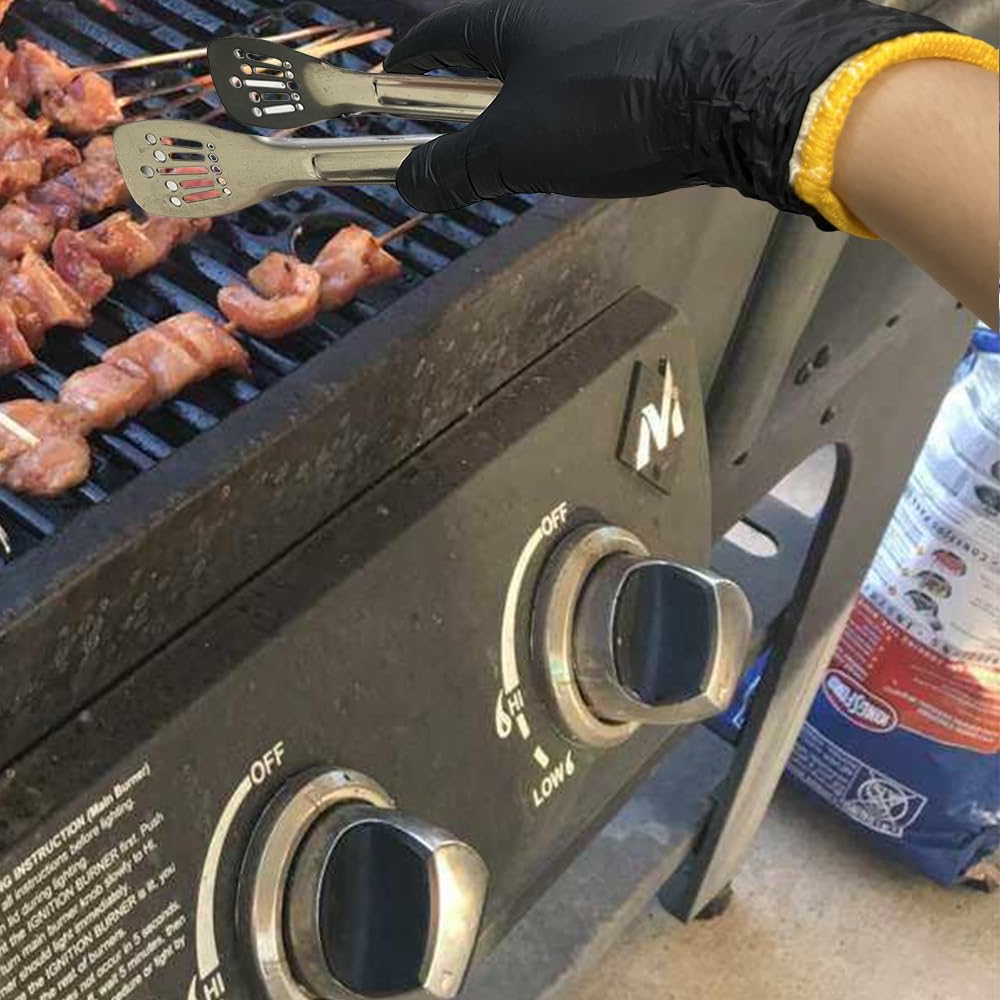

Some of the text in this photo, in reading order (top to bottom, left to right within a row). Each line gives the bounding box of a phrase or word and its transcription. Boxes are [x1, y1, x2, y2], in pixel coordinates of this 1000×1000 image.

[541, 501, 569, 535] OFF
[507, 690, 525, 716] HI
[250, 740, 286, 785] OFF
[532, 763, 566, 807] LOW
[13, 815, 85, 880] INSTRUCTION
[15, 852, 68, 900] instructions
[69, 826, 99, 855] before
[9, 929, 26, 947] the
[27, 885, 74, 932] IGNITION
[75, 848, 119, 891] BURNER
[140, 813, 164, 837] Push
[0, 954, 21, 976] turn
[22, 933, 46, 958] main
[47, 904, 78, 936] burner
[80, 885, 103, 908] knob
[104, 860, 131, 888] slowly
[132, 851, 143, 863] to
[7, 910, 20, 927] lid
[21, 886, 52, 916] during
[28, 977, 44, 994] the
[45, 931, 93, 979] IGNITION
[94, 895, 137, 938] BURNER
[159, 863, 175, 885] you
[19, 946, 52, 981] should
[52, 929, 74, 952] light
[78, 956, 87, 973] of
[80, 972, 95, 992] not
[97, 950, 121, 977] occur
[123, 942, 133, 954] in
[133, 932, 141, 945] 5
[119, 965, 126, 978] 5
[153, 945, 172, 967] light
[173, 935, 185, 950] by
[203, 972, 225, 1000] HI
